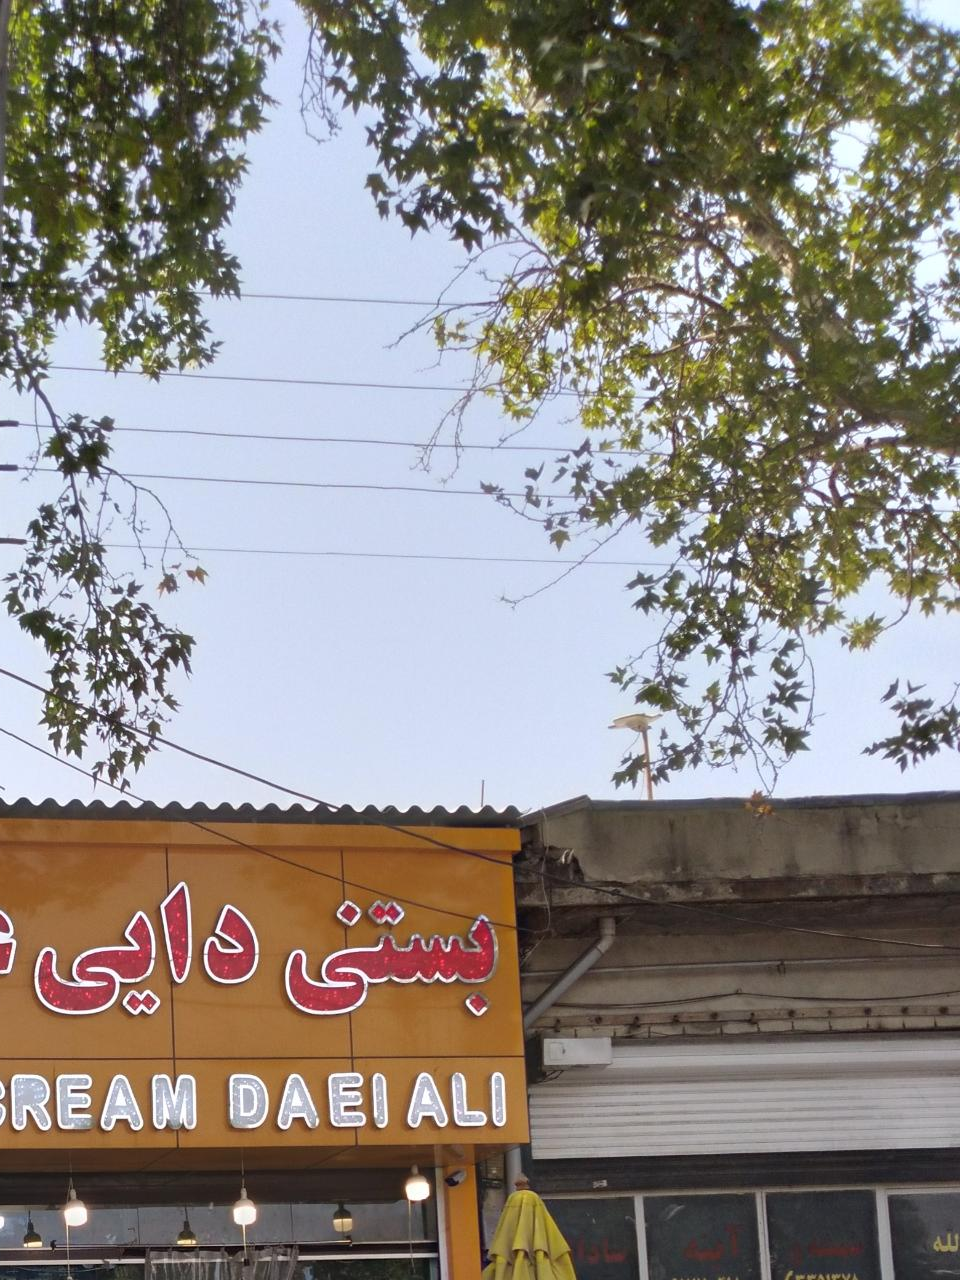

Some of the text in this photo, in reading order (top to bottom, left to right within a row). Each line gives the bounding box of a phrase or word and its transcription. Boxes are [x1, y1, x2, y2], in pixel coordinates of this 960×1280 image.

[34, 881, 260, 1016] دایی
[284, 899, 500, 1018] بستنی
[228, 1072, 389, 1130] DAEI
[407, 1071, 507, 1129] ALI
